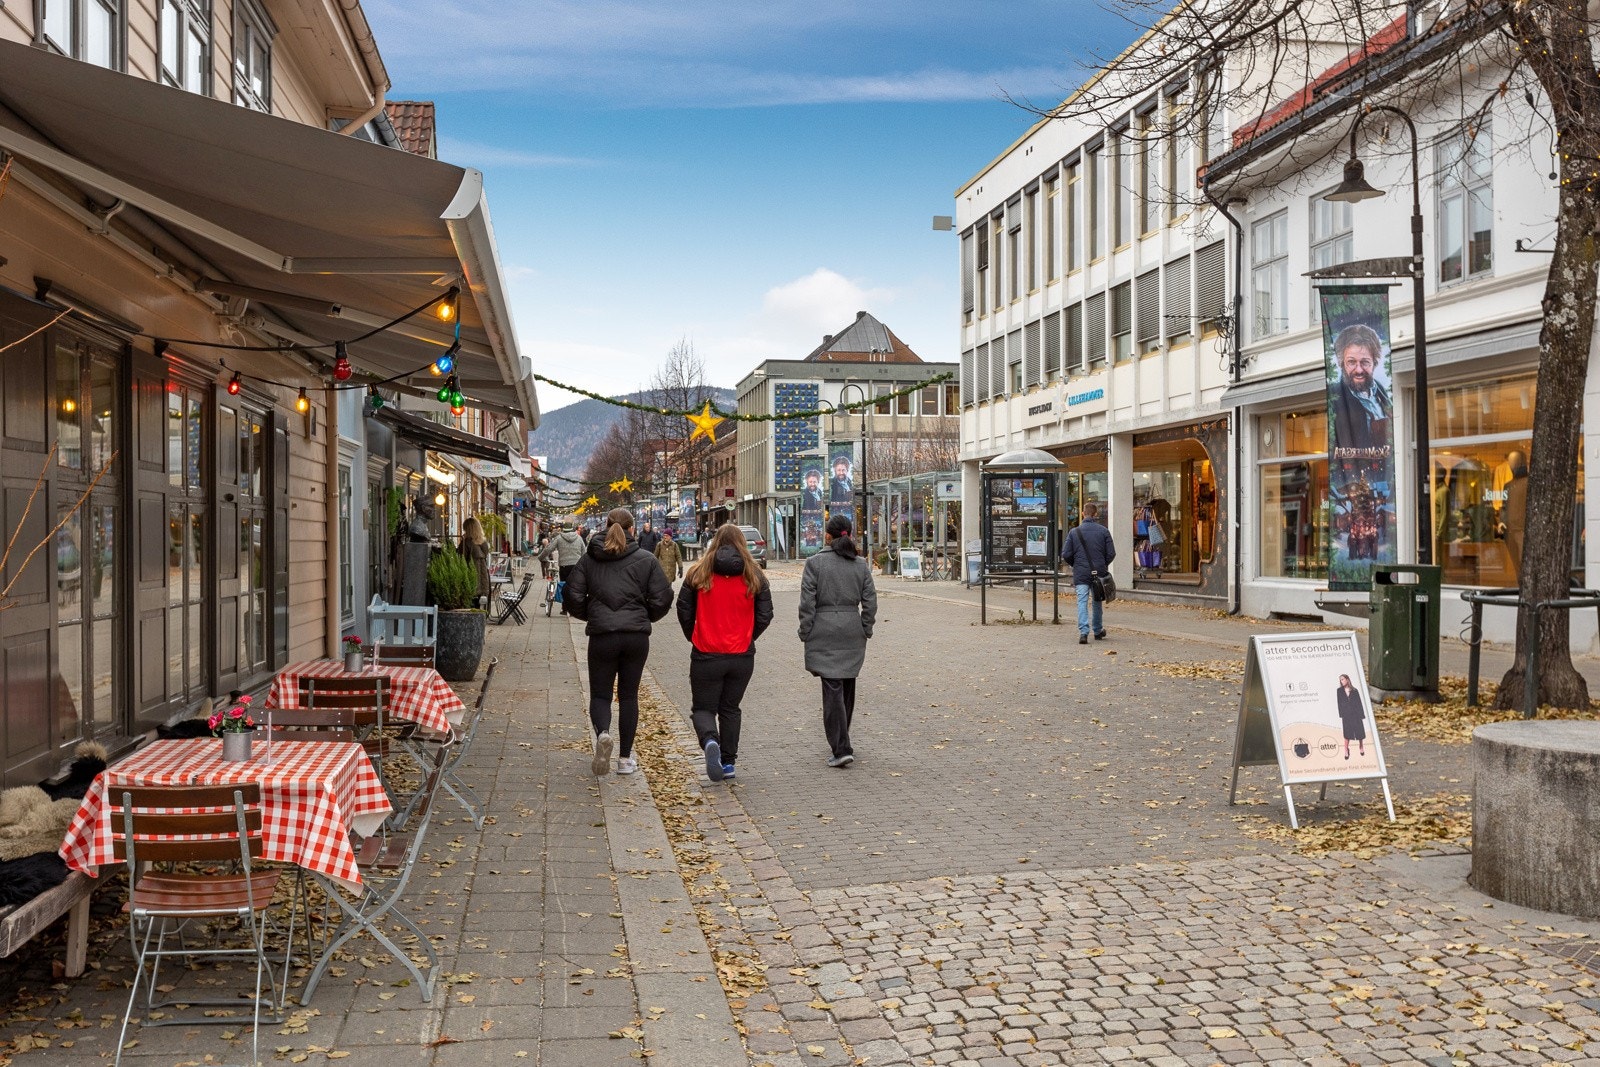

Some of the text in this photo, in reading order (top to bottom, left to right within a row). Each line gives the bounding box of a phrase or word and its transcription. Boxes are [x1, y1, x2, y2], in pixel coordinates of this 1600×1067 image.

[1482, 488, 1508, 501] Janus
[1265, 642, 1351, 655] atter secondhand
